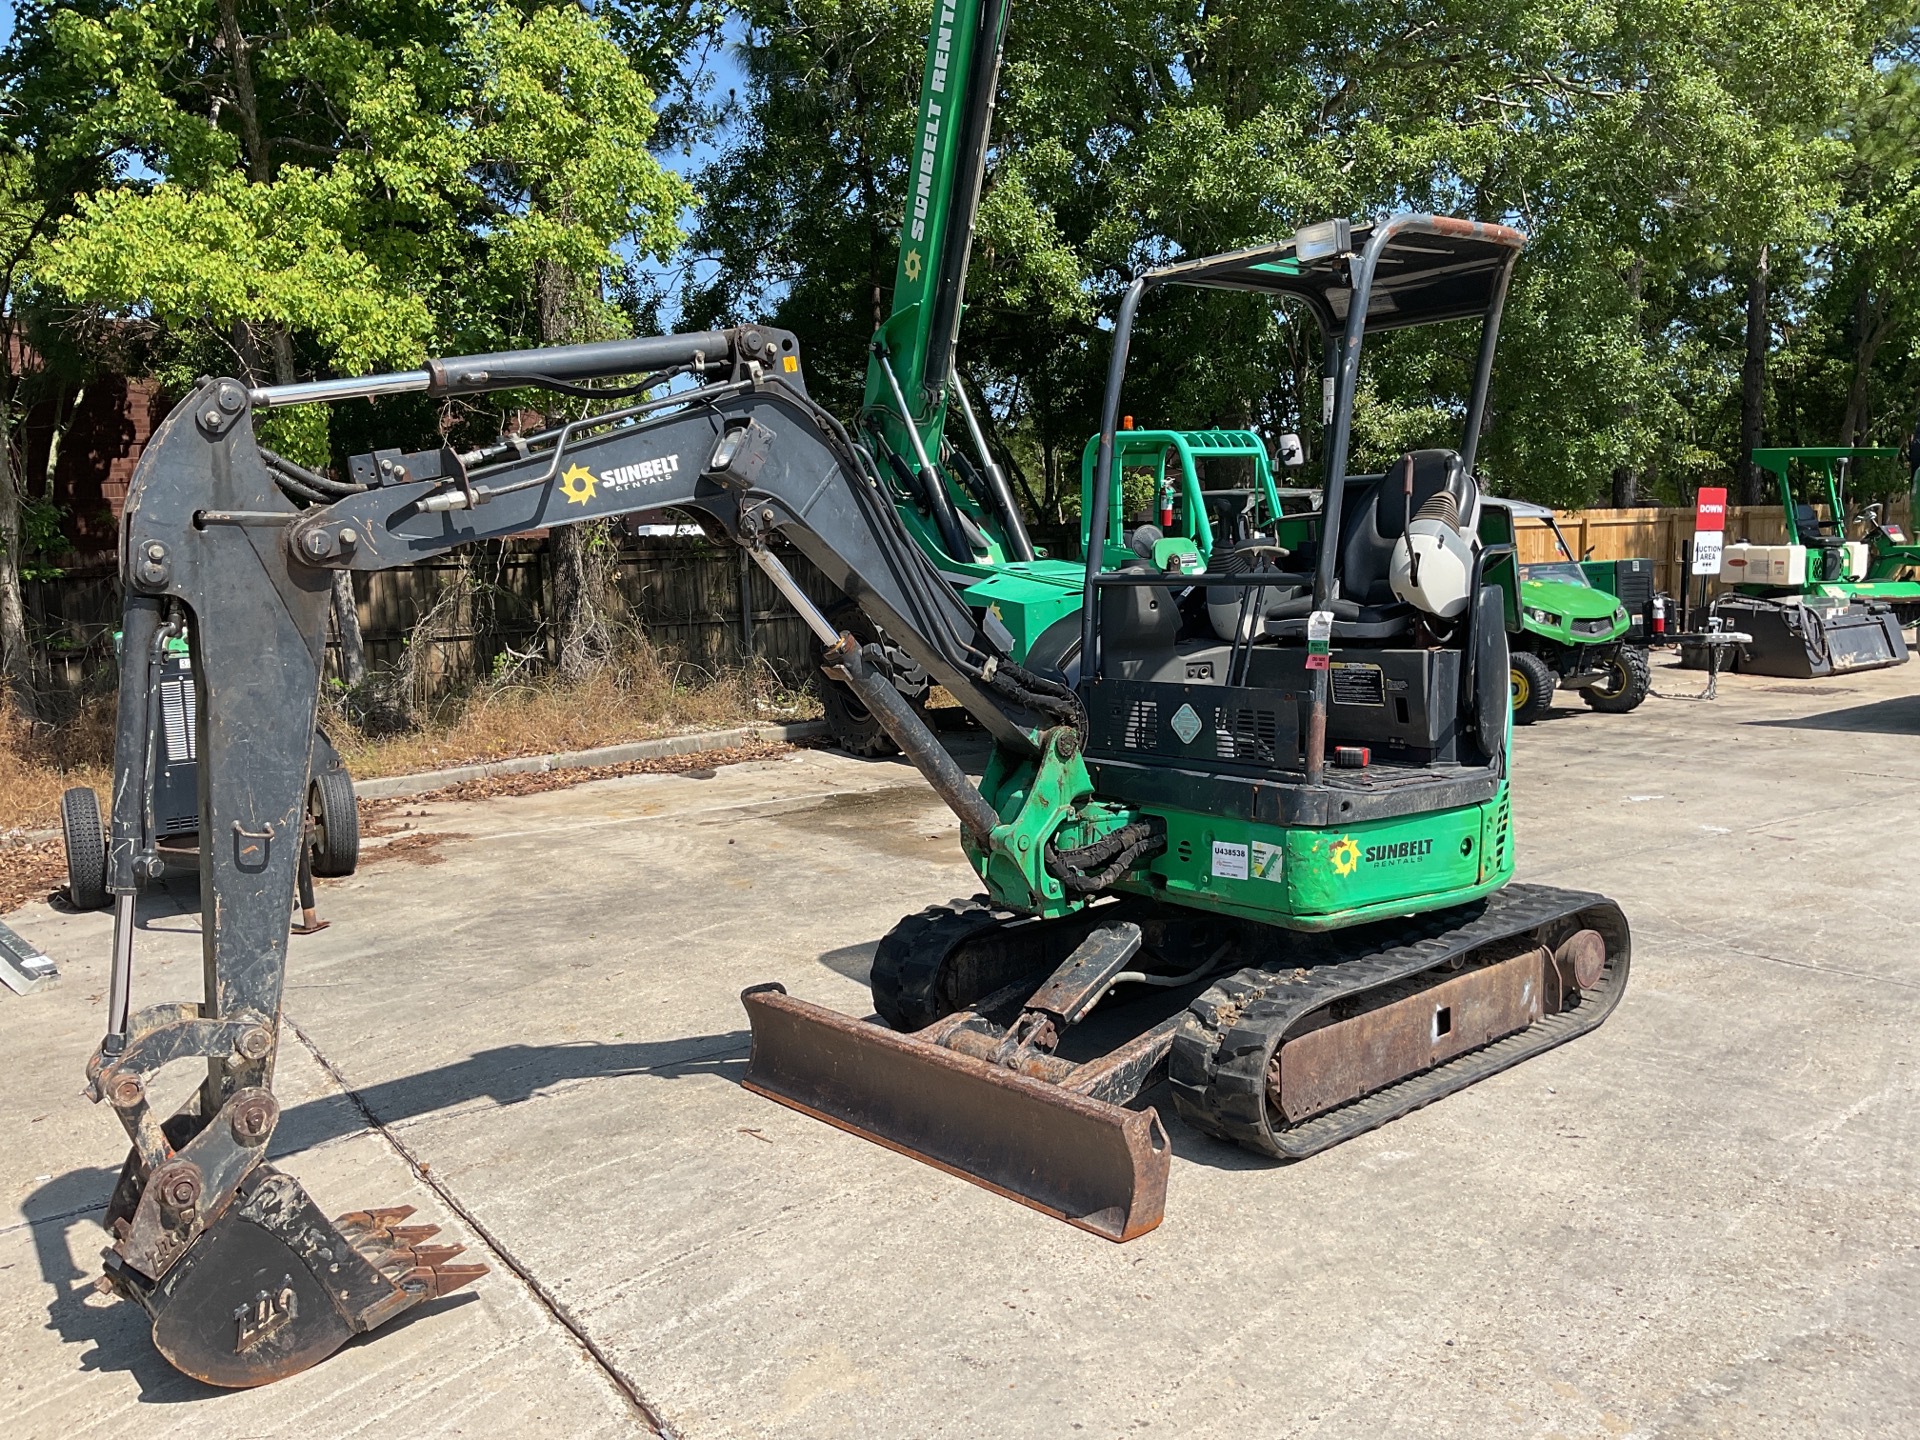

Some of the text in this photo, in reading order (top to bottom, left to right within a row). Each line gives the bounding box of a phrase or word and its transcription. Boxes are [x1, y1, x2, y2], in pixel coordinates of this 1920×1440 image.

[911, 98, 942, 242] SUNBELT
[600, 454, 679, 488] SUNBELT
[615, 473, 672, 492] RENTALS
[1699, 504, 1723, 514] DOWN
[1700, 553, 1716, 561] AREA
[1214, 847, 1246, 858] U438538
[1365, 839, 1433, 862] SUNBELT
[1374, 856, 1423, 868] RENTALS
